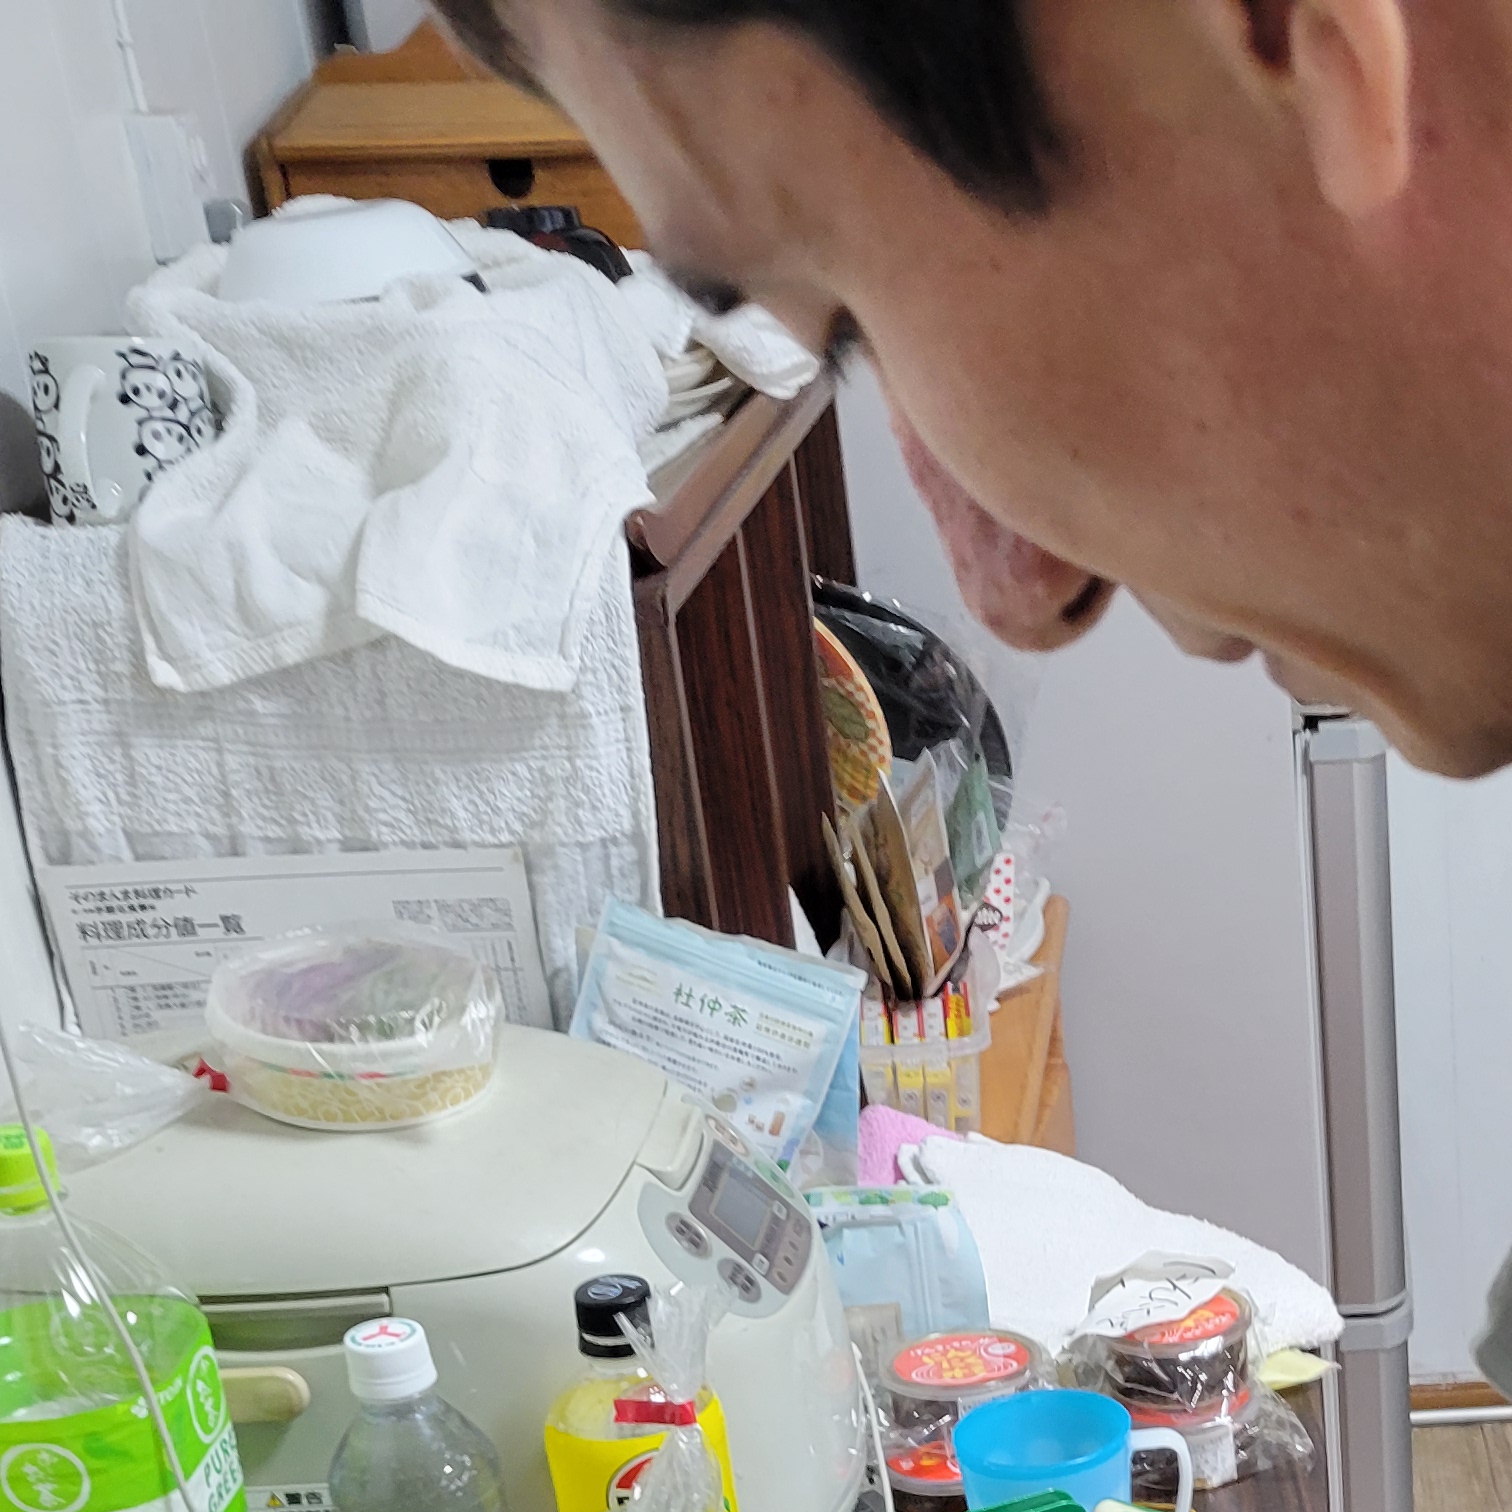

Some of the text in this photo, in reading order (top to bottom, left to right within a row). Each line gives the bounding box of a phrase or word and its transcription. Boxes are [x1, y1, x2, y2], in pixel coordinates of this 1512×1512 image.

[76, 913, 246, 942] 料理成分値一覧
[673, 982, 749, 1028] 杜仲茶
